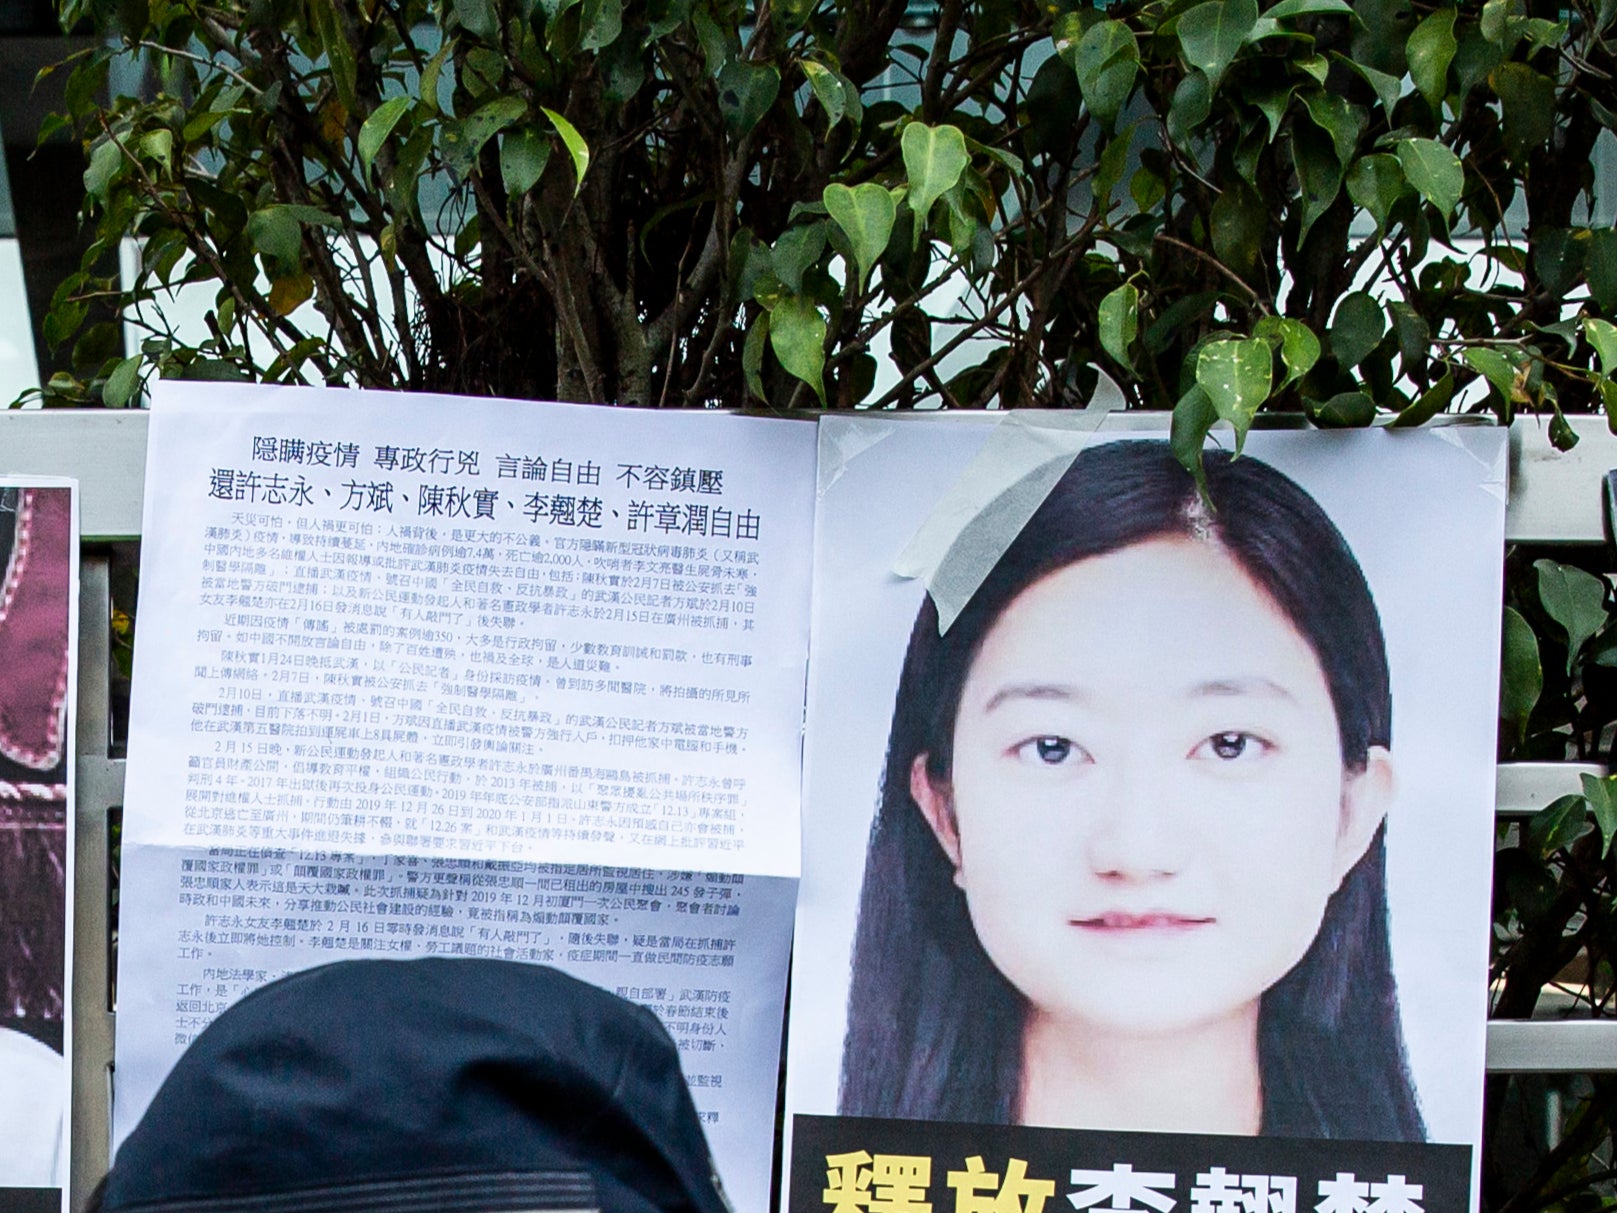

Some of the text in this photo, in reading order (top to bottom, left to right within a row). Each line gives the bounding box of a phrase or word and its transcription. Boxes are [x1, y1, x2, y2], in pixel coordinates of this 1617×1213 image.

[495, 452, 602, 486] 言論自由
[615, 462, 724, 496] 不容鎮壓
